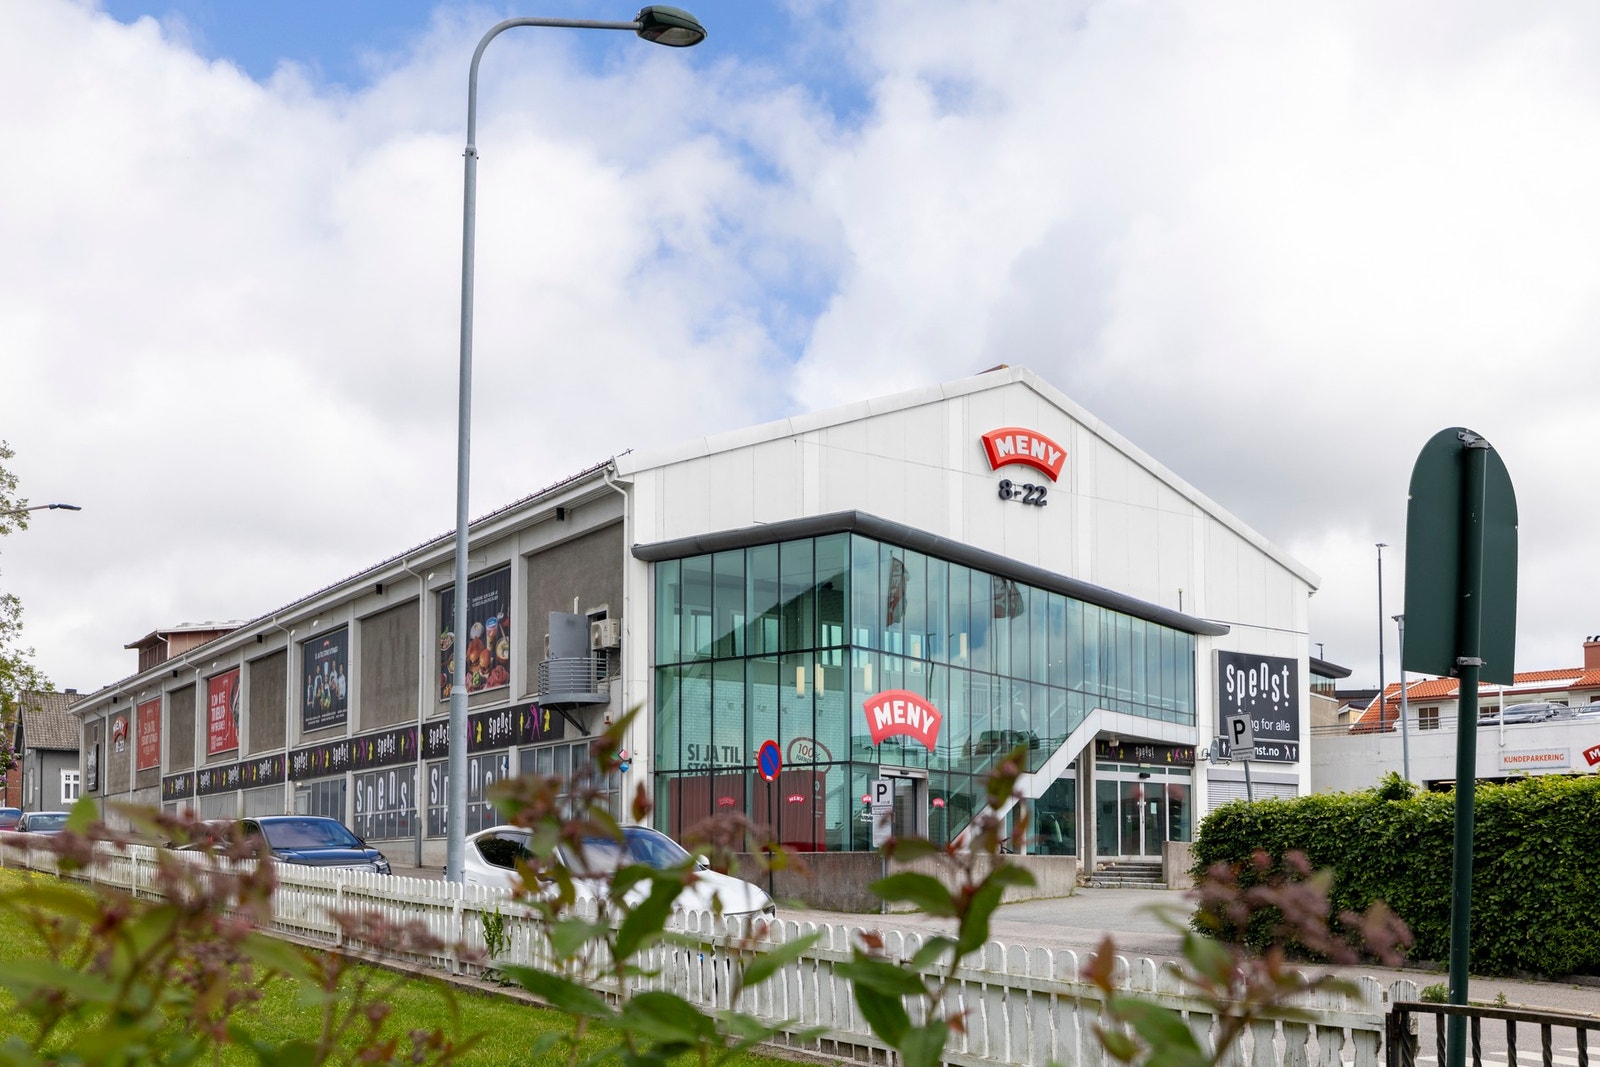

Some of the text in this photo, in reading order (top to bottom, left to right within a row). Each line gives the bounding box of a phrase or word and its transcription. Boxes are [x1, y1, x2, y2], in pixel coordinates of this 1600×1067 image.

[995, 435, 1062, 467] MENY
[998, 479, 1048, 507] 8-22
[1226, 662, 1290, 712] spenst
[488, 710, 513, 745] spenst
[873, 700, 935, 735] MENY
[1261, 718, 1274, 731] for
[1275, 720, 1291, 732] alle
[1233, 719, 1246, 745] P
[377, 733, 396, 763] spenst
[687, 744, 700, 761] SI
[703, 745, 720, 762] JA
[721, 746, 741, 764] TIL
[1503, 753, 1565, 764] KUNDEPARKERING
[788, 795, 804, 803] MENY
[876, 783, 888, 803] P
